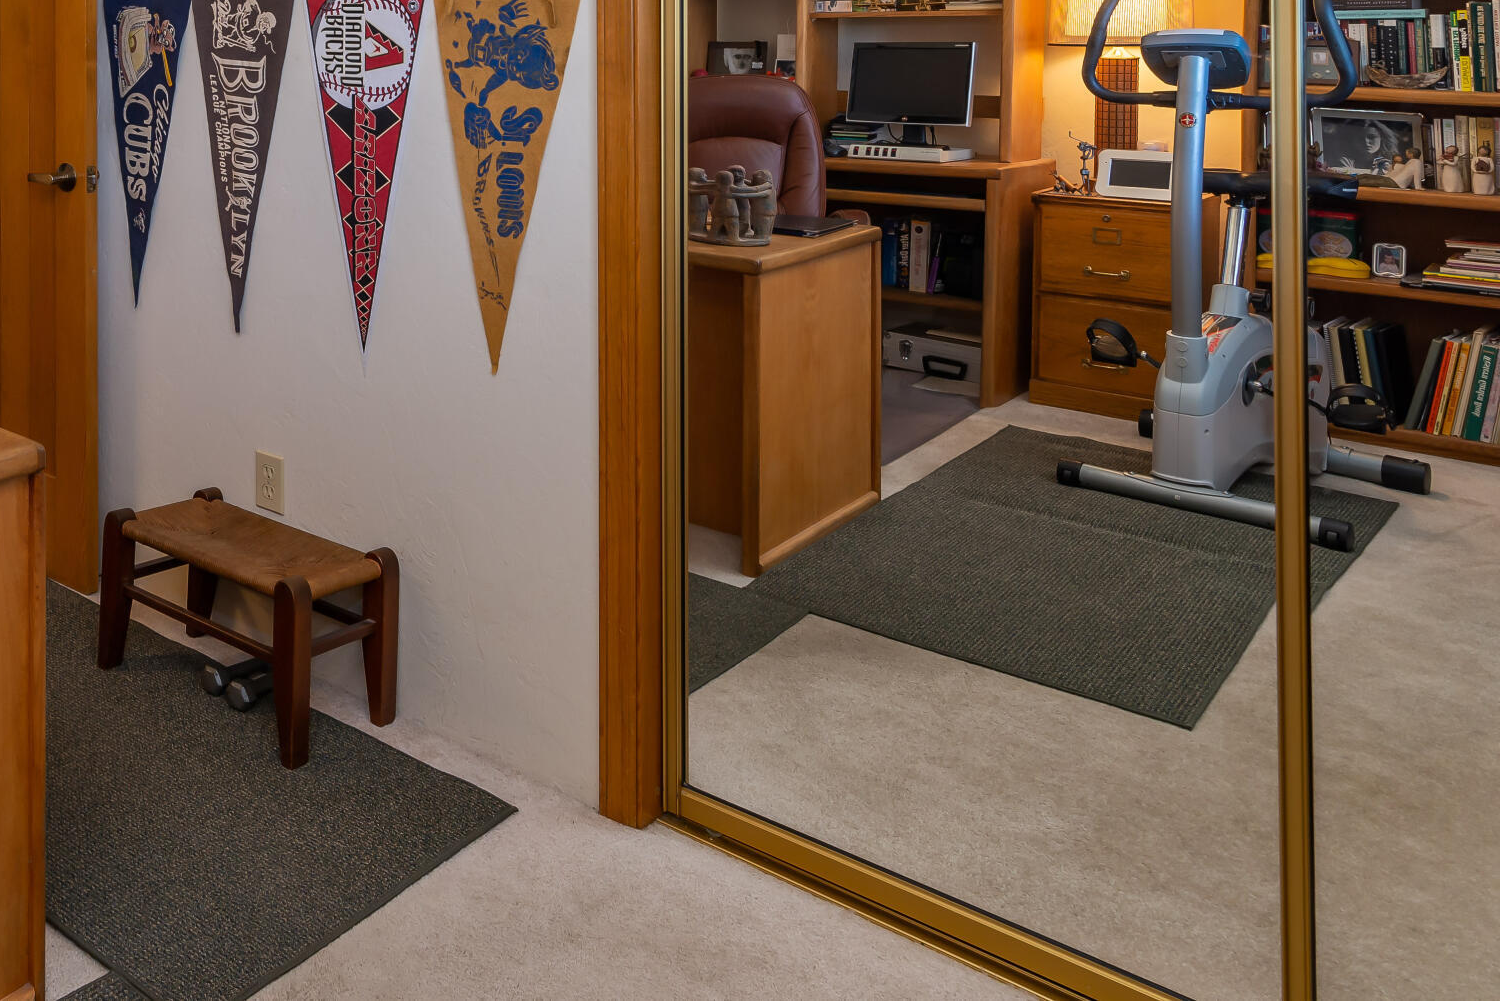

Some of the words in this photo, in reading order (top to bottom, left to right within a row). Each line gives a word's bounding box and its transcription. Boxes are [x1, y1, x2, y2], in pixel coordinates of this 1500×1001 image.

[321, 15, 343, 75] BACKS
[340, 3, 364, 87] DIAMOND
[150, 83, 170, 183] Chicago
[209, 74, 221, 114] LEAGUE
[218, 100, 231, 156] NATIONAL
[122, 92, 154, 202] CUBS
[210, 52, 267, 278] BROOKLYN
[214, 121, 228, 182] CHAMPIONS
[352, 94, 378, 282] ARIZONA
[472, 152, 495, 247] BROWNS
[496, 151, 525, 240] LOUIS
